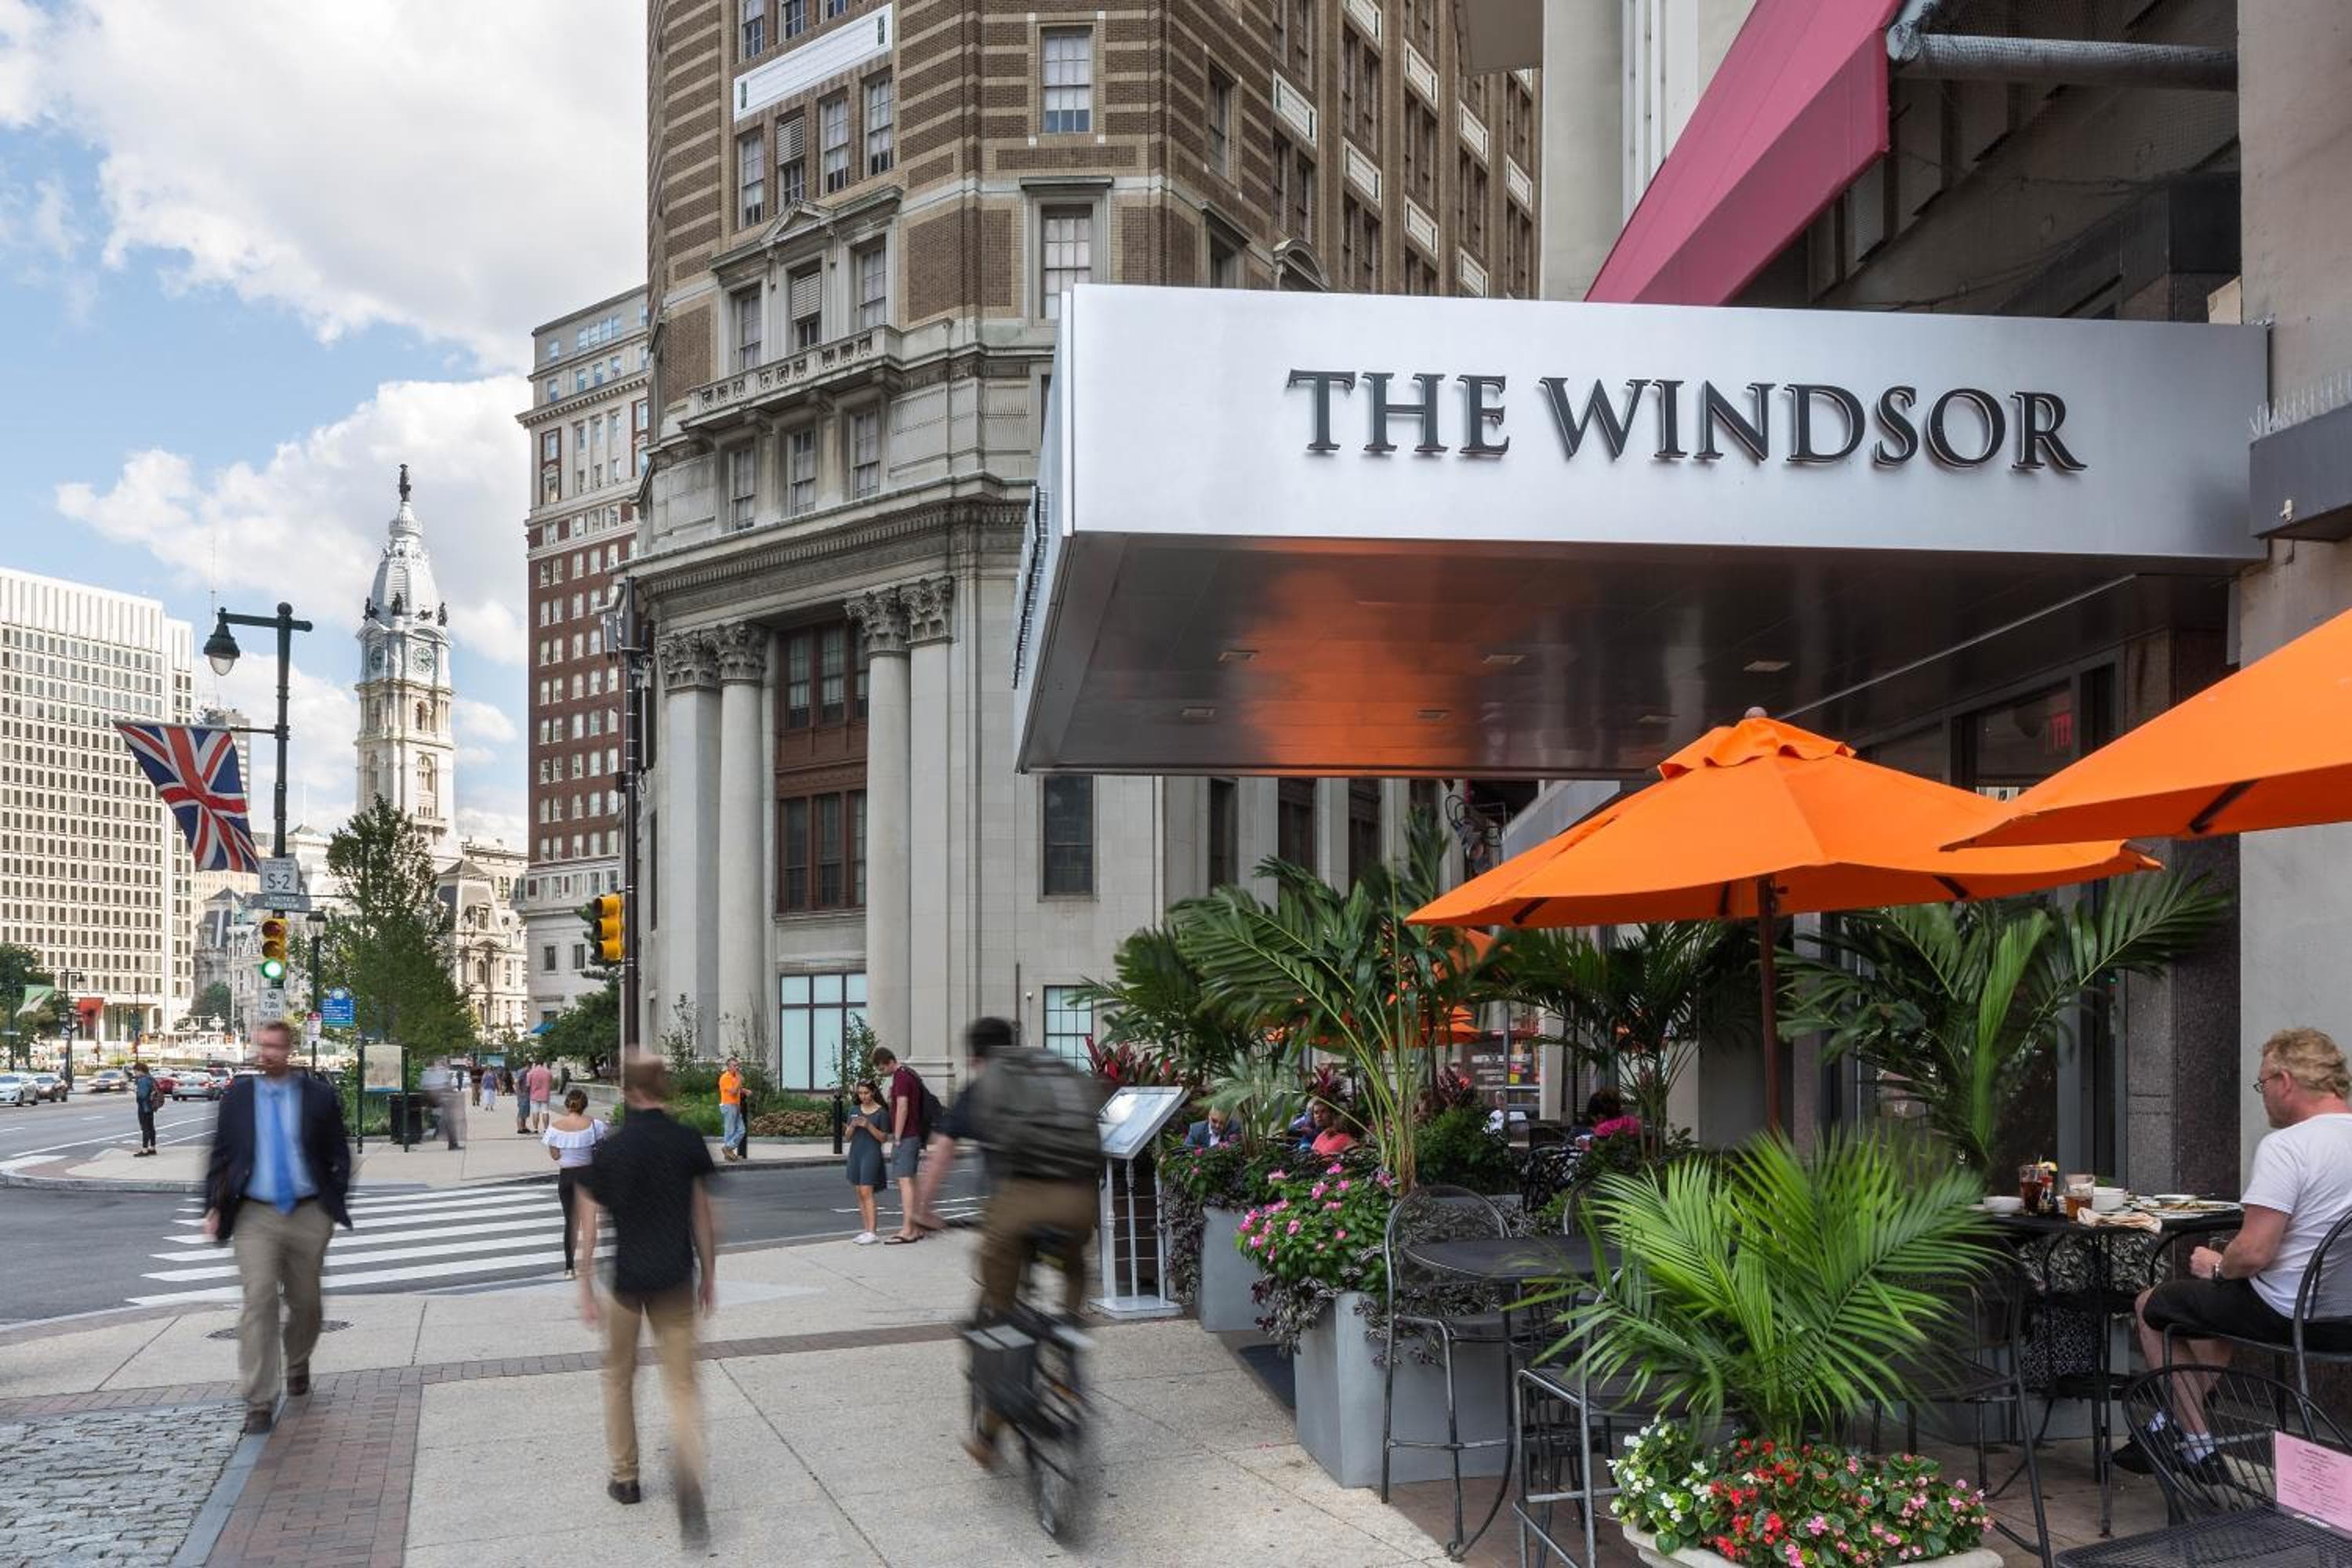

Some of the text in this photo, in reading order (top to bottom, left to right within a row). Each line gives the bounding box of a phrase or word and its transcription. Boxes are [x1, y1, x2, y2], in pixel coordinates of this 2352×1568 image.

[1287, 368, 2089, 472] THE WINDSOR
[267, 873, 291, 890] S-2
